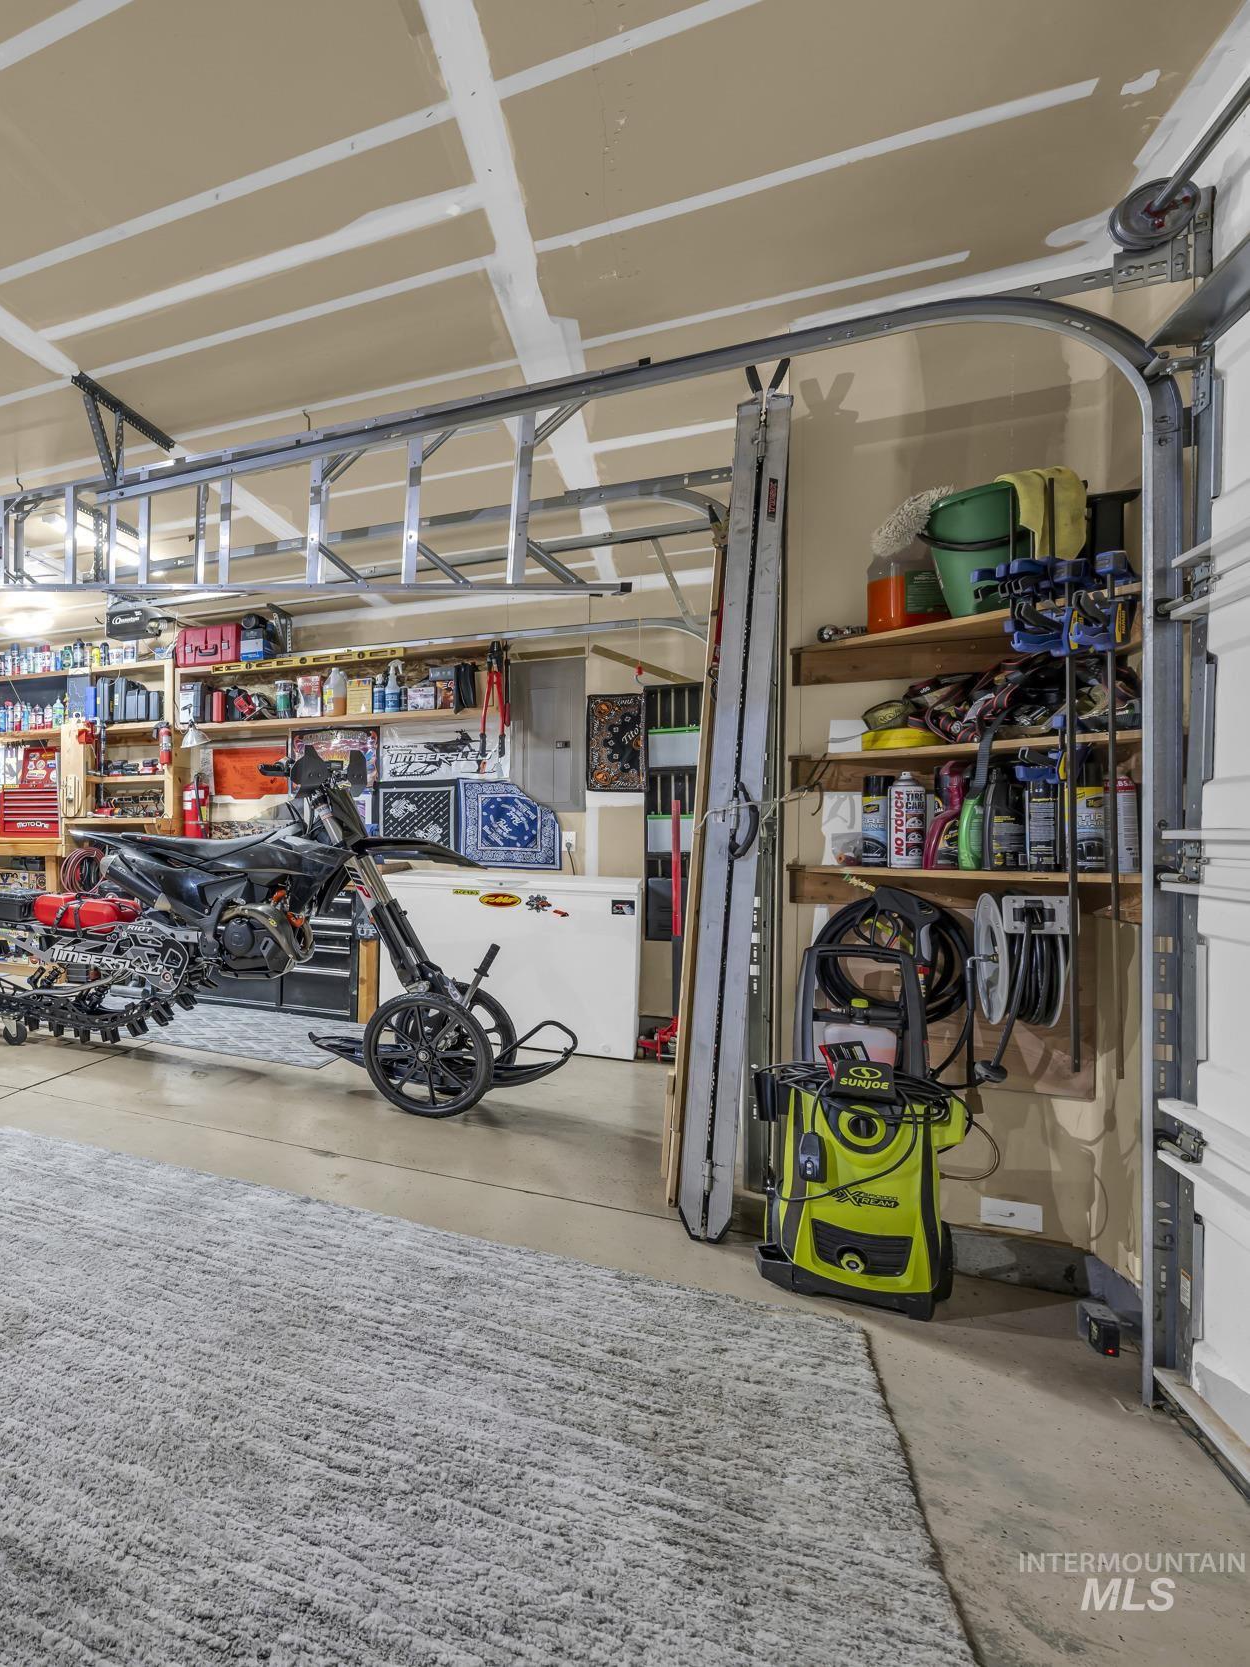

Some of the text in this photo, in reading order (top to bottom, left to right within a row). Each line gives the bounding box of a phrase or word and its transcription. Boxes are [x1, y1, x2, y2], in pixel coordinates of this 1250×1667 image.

[894, 790, 905, 857] NO TOUCH
[126, 924, 152, 932] RIOT
